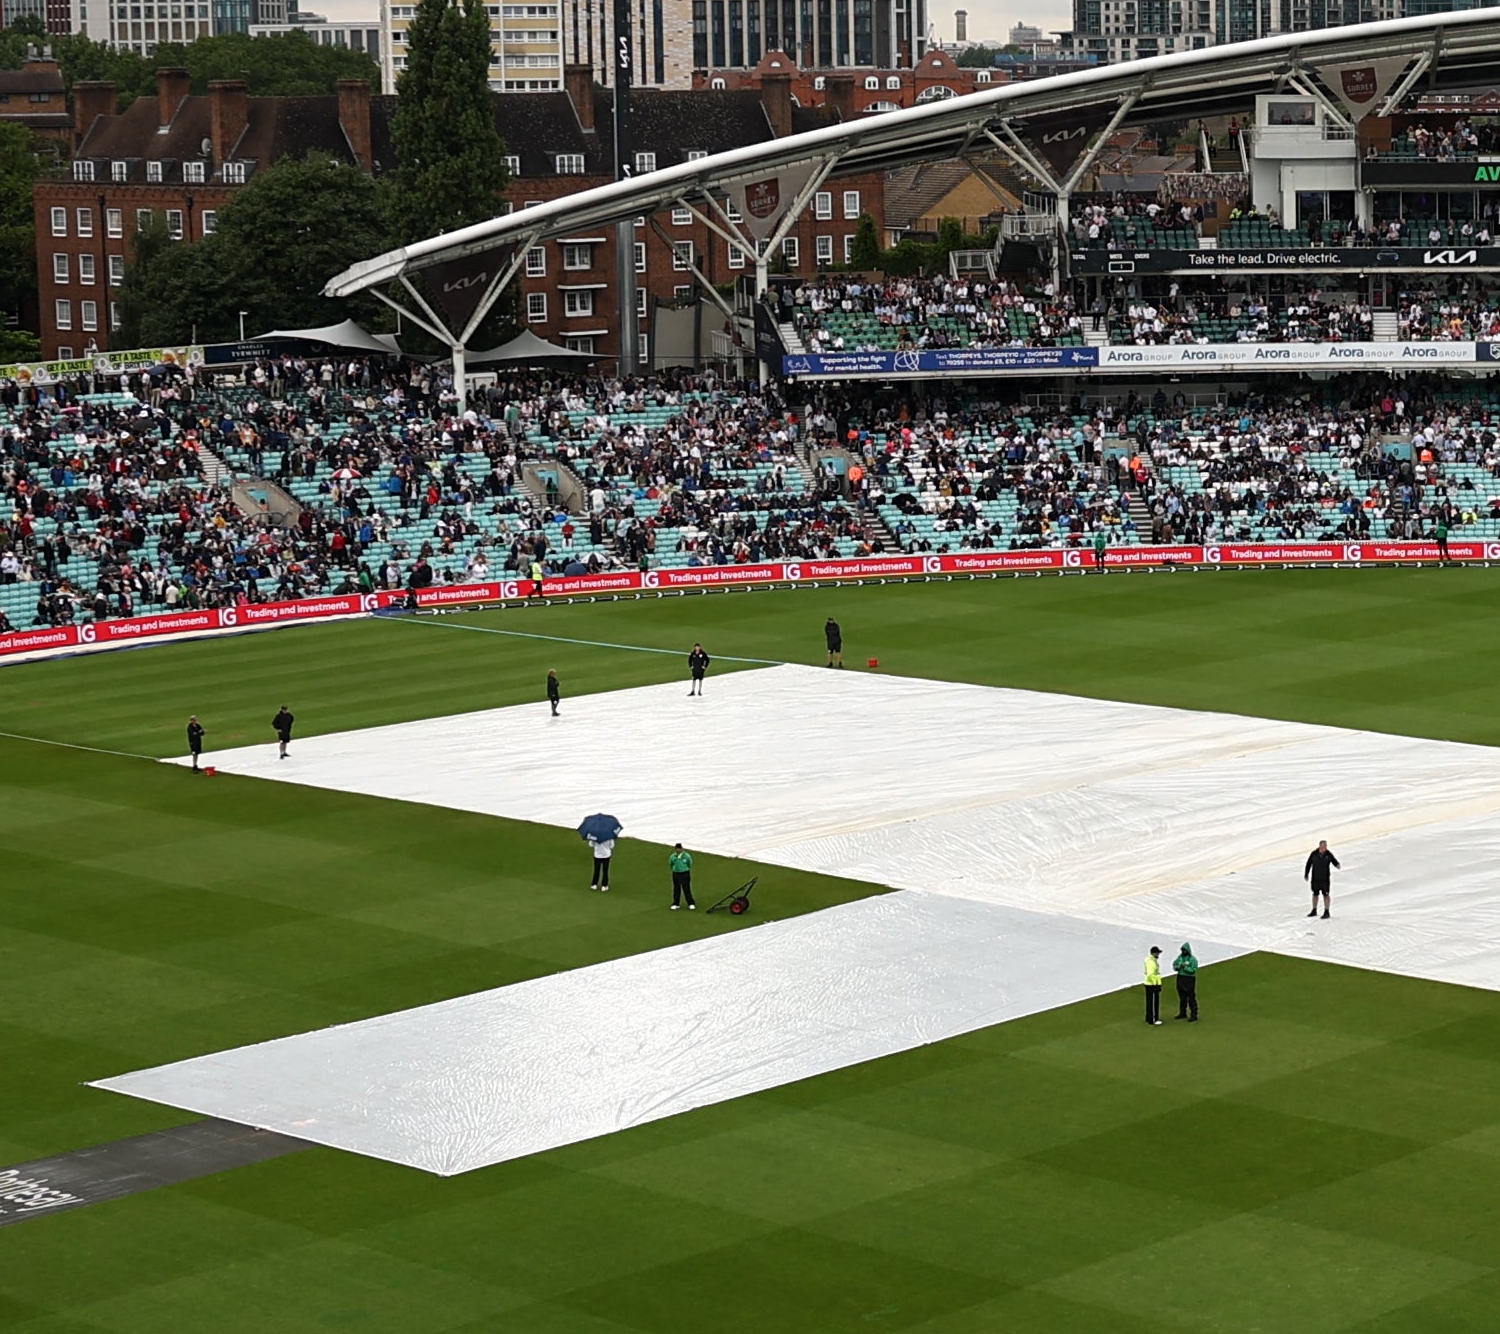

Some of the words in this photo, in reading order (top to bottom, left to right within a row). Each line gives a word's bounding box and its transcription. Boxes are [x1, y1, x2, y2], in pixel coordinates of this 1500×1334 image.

[1189, 254, 1214, 264] Take
[1217, 254, 1235, 264] the
[1238, 254, 1264, 264] lead.
[1267, 253, 1296, 264] Drive
[1299, 253, 1341, 264] electric.
[109, 353, 123, 363] GET
[124, 353, 129, 361] A
[130, 352, 150, 361] TASTE
[819, 356, 854, 365] Supporting
[869, 356, 887, 364] fight
[1107, 350, 1143, 362] Arora
[1144, 354, 1173, 362] GROUP
[1181, 349, 1217, 361] Arora
[112, 362, 122, 371] OF
